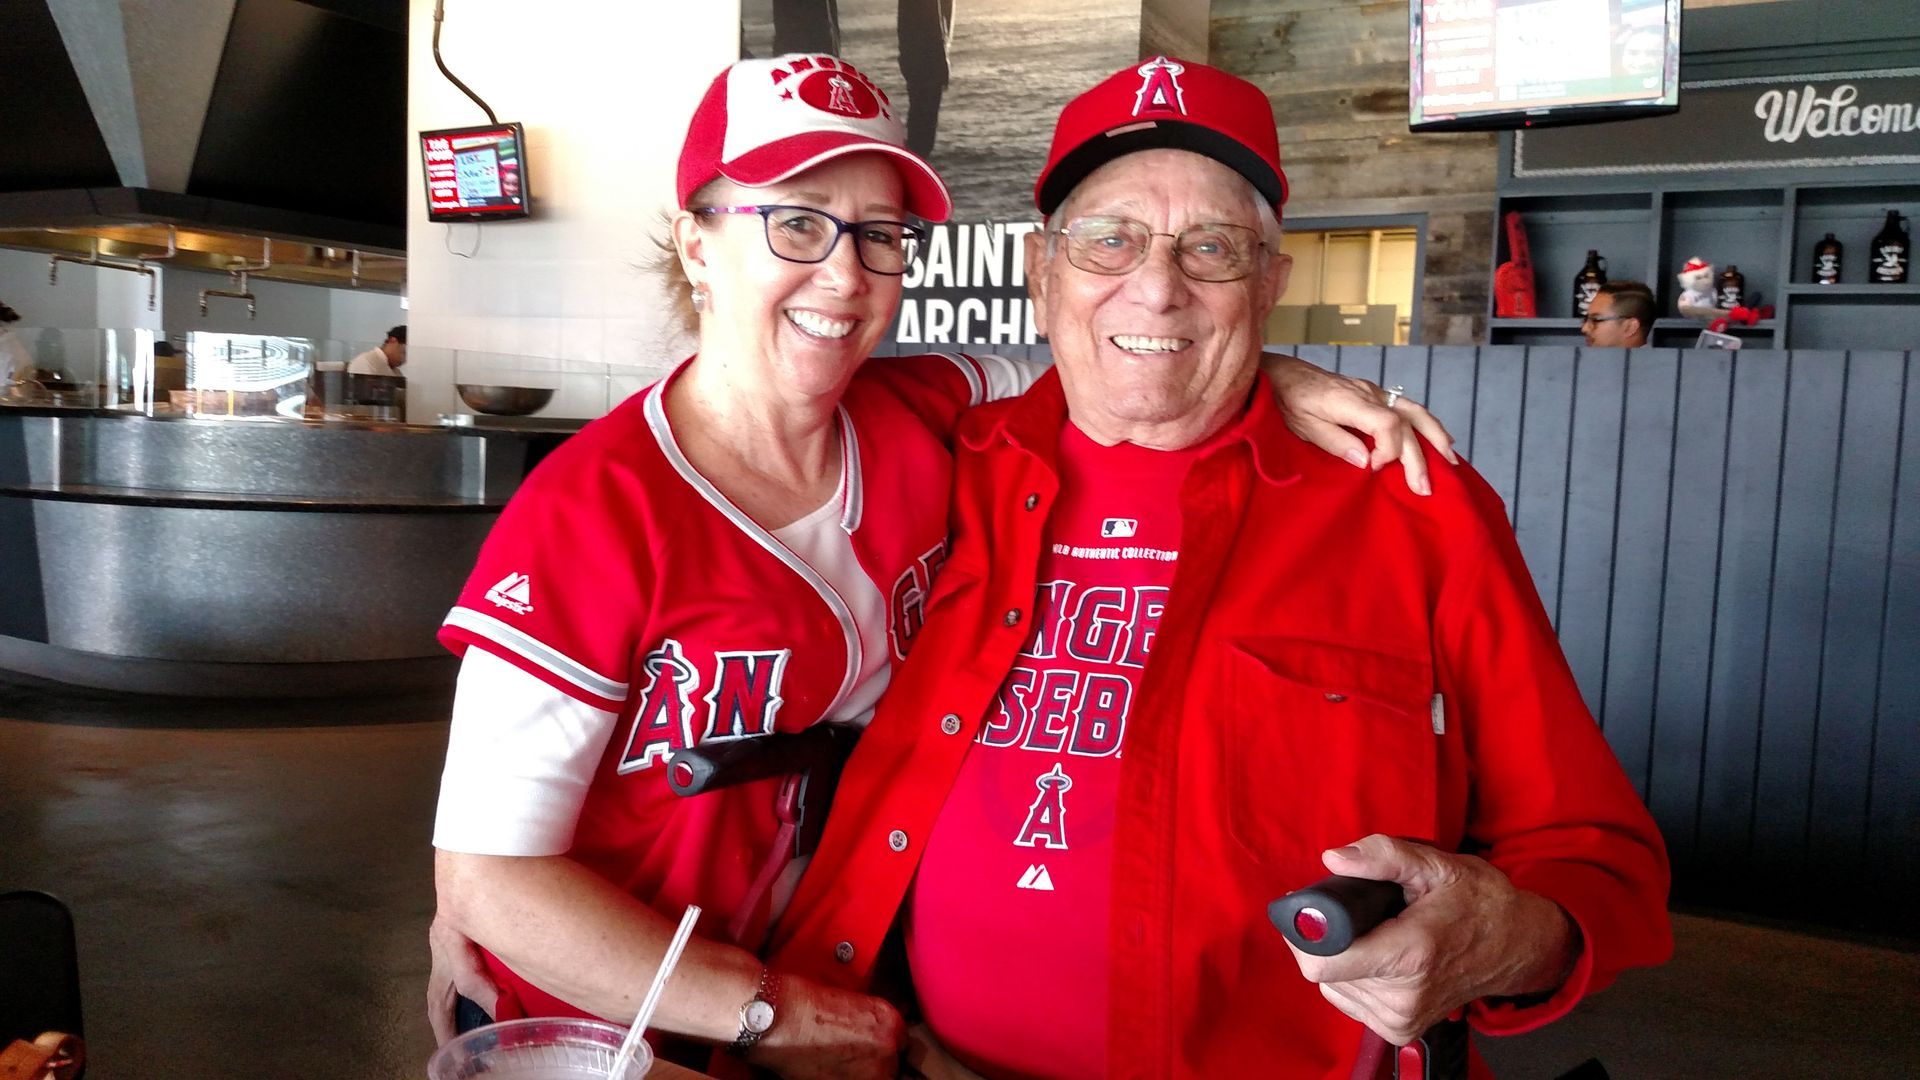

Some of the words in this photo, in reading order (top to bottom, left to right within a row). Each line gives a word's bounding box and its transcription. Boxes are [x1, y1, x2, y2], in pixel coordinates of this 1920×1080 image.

[1754, 84, 1920, 143] Welcom
[1071, 546, 1121, 560] AUTHENTIC
[1121, 546, 1179, 562] COLLECTION
[975, 667, 1132, 758] SEB
